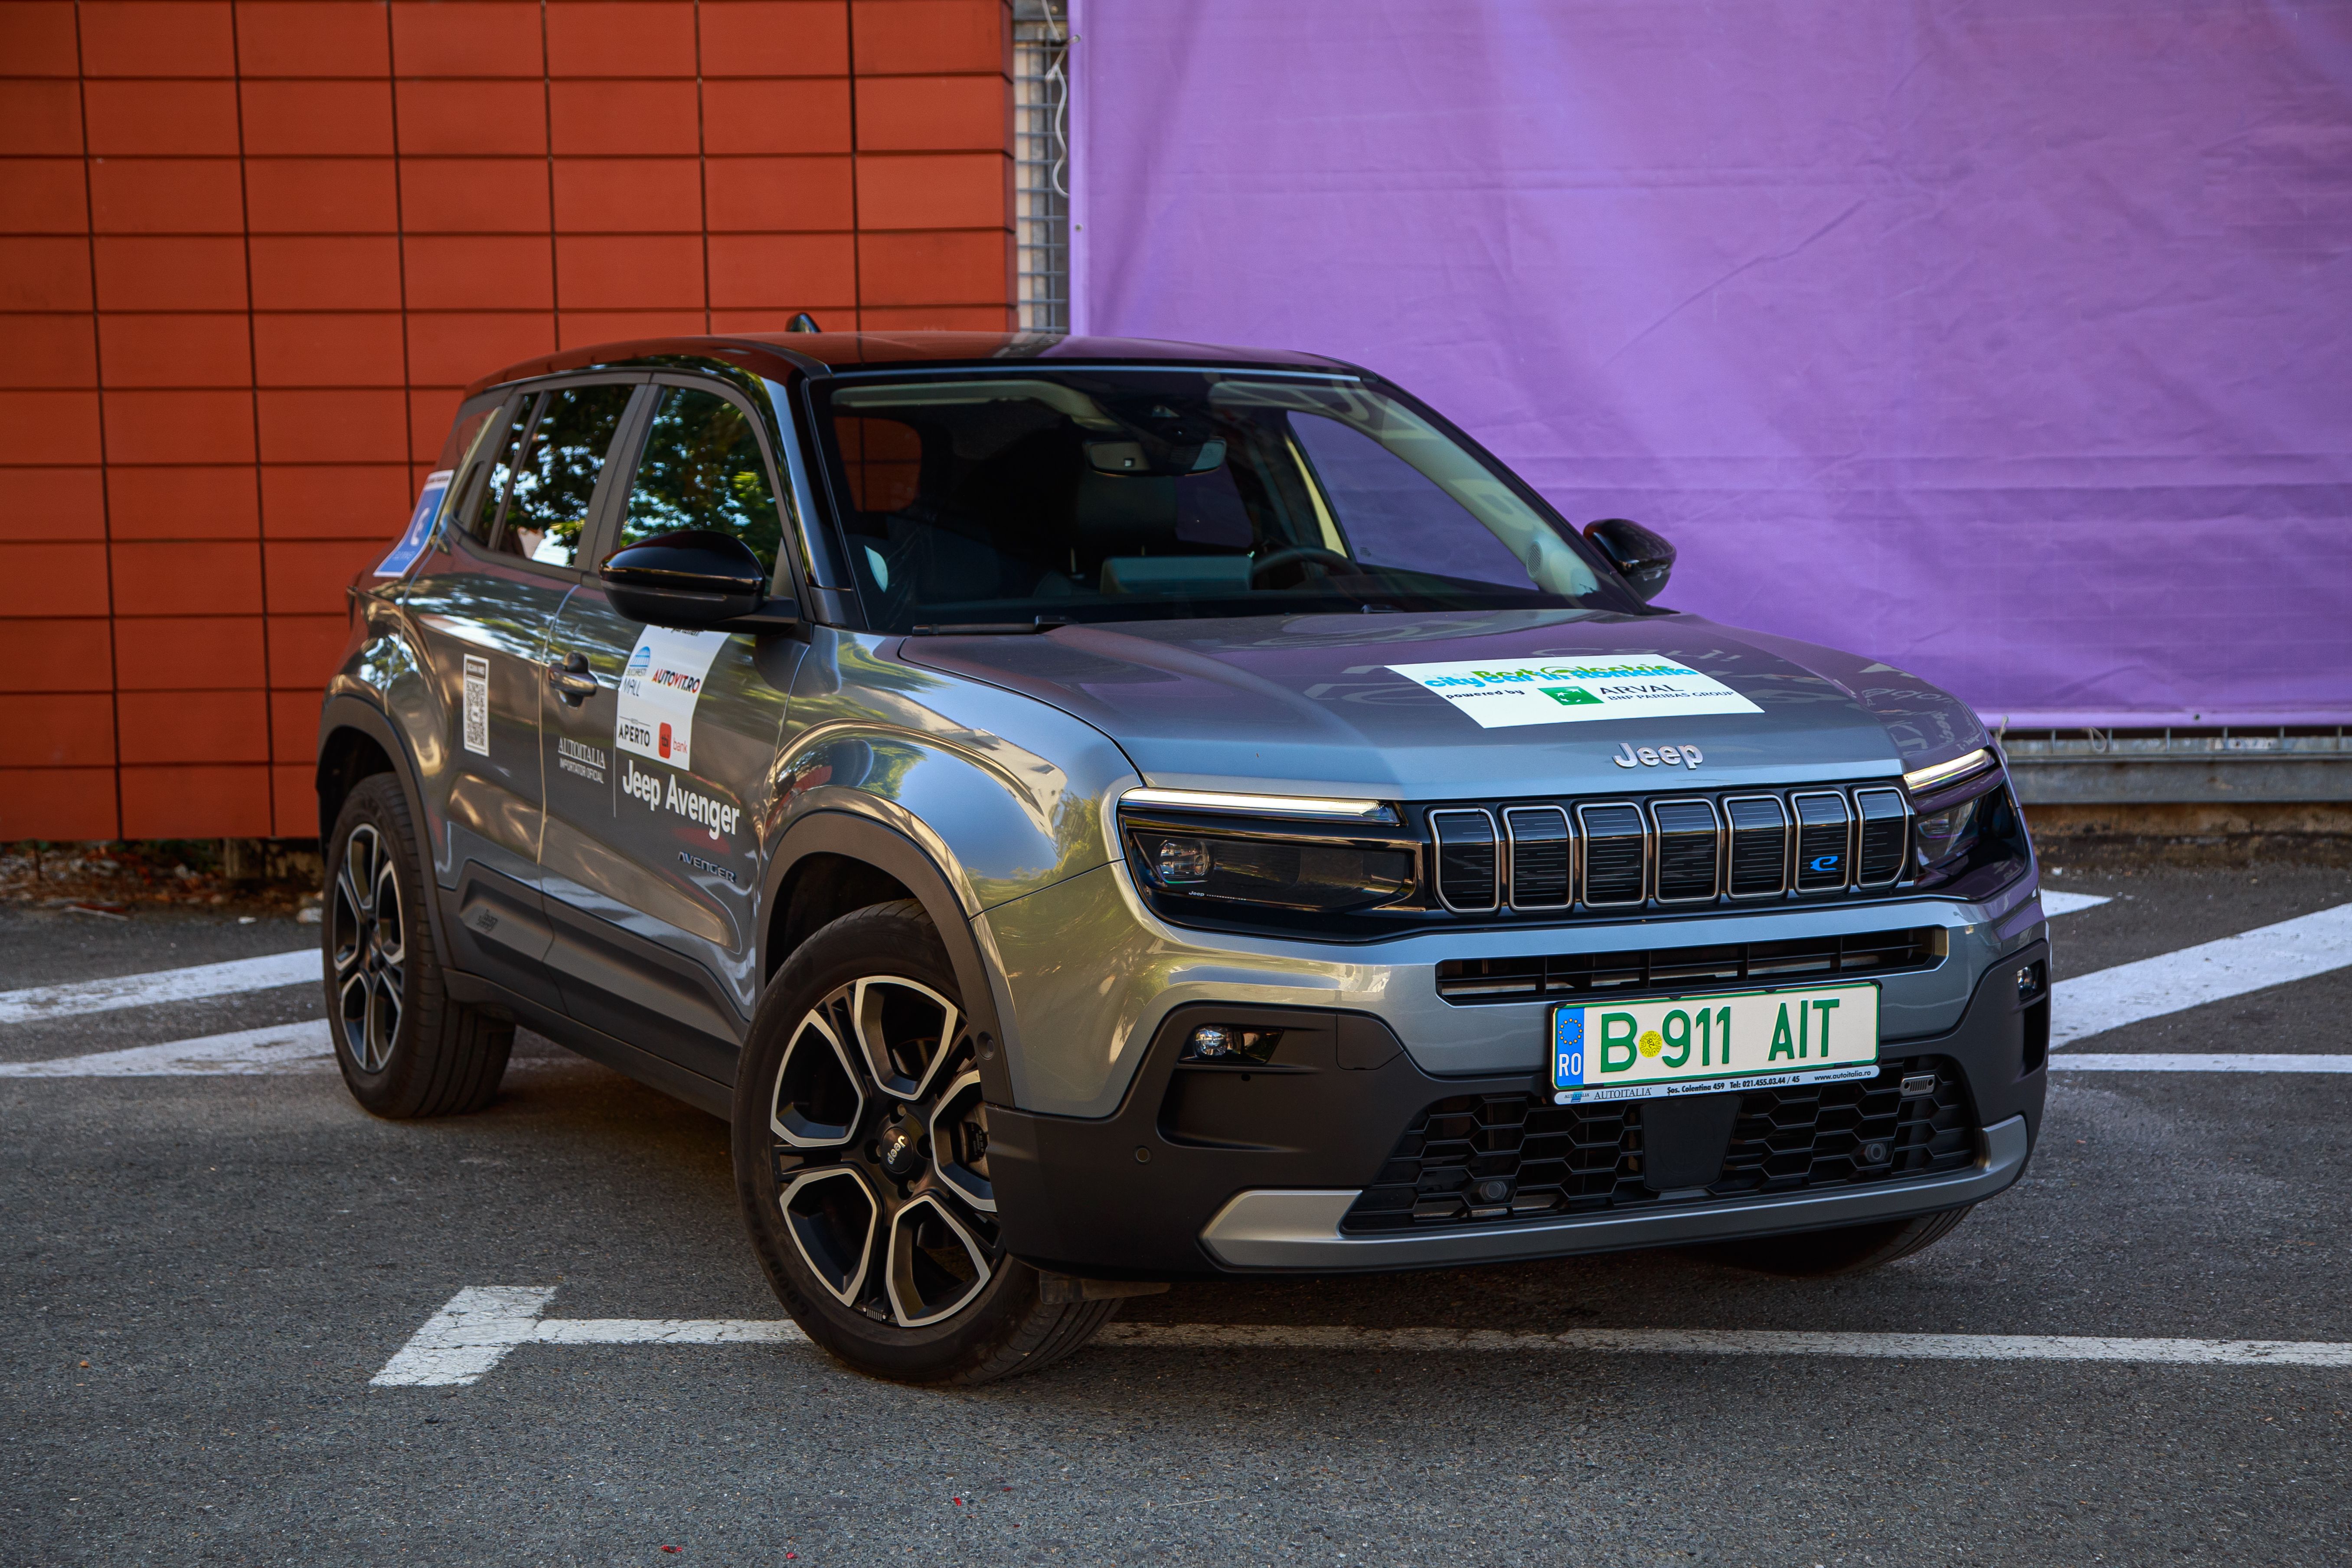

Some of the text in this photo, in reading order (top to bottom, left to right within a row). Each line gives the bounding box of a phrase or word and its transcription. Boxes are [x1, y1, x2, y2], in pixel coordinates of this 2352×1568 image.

[652, 667, 700, 693] AUTOVIT.RO
[1424, 676, 1486, 687] city
[1483, 675, 1535, 683] car
[1600, 684, 1684, 694] ARVAL
[1446, 690, 1503, 699] powered
[618, 723, 650, 747] APERTO
[673, 737, 687, 754] bank
[558, 737, 606, 769] AUTOITALIA
[1611, 742, 1704, 770] Jeep
[622, 759, 740, 840] Jeep Avenger
[678, 851, 736, 883] AVENGER
[1601, 999, 1839, 1073] B 911 AIT
[1558, 1052, 1582, 1077] RO
[1594, 1087, 1652, 1100] AUTOITALIA
[1682, 1084, 1711, 1093] Colentina
[1742, 1077, 1785, 1088] 021.455.03.44
[1814, 1069, 1872, 1081] www.autoitalia.ro
[888, 1135, 906, 1165] Jeep
